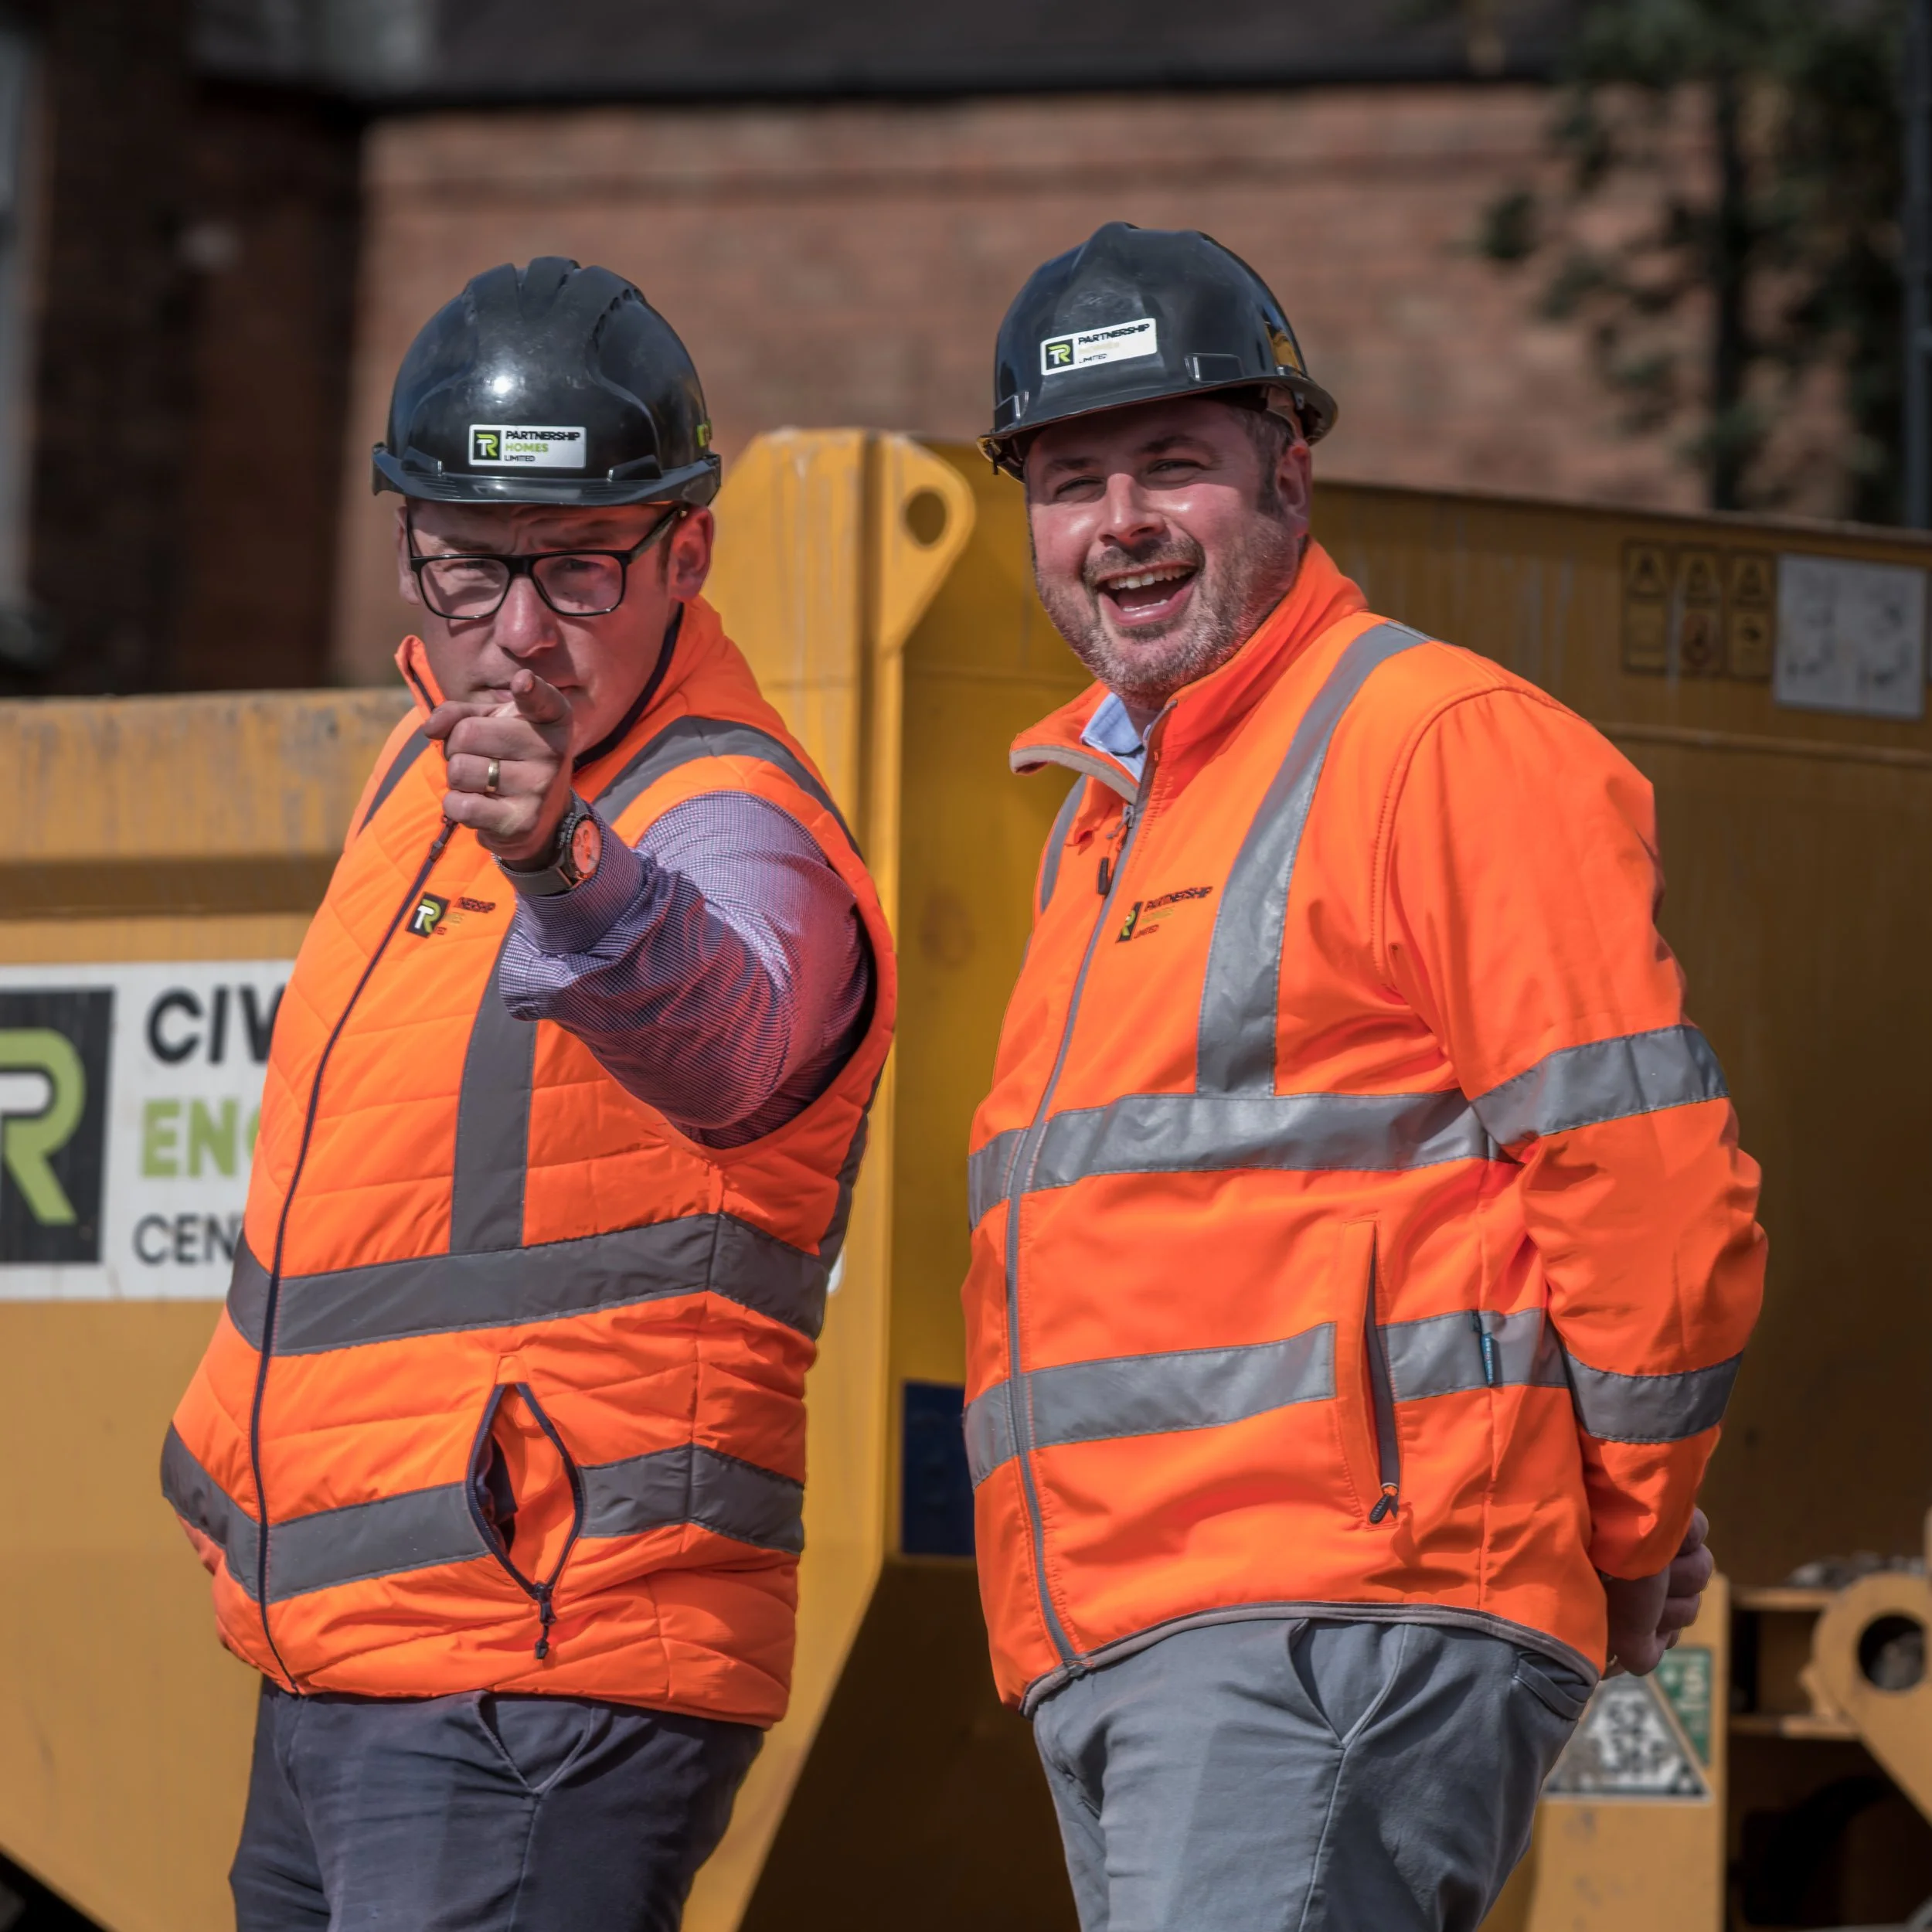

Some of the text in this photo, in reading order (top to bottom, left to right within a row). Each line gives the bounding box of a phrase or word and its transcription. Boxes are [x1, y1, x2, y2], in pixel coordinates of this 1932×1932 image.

[1078, 323, 1150, 345] PARTNERSHIP
[505, 430, 580, 441] PARTNERSHIP
[505, 443, 549, 453] HOMES
[140, 1099, 261, 1178] EN
